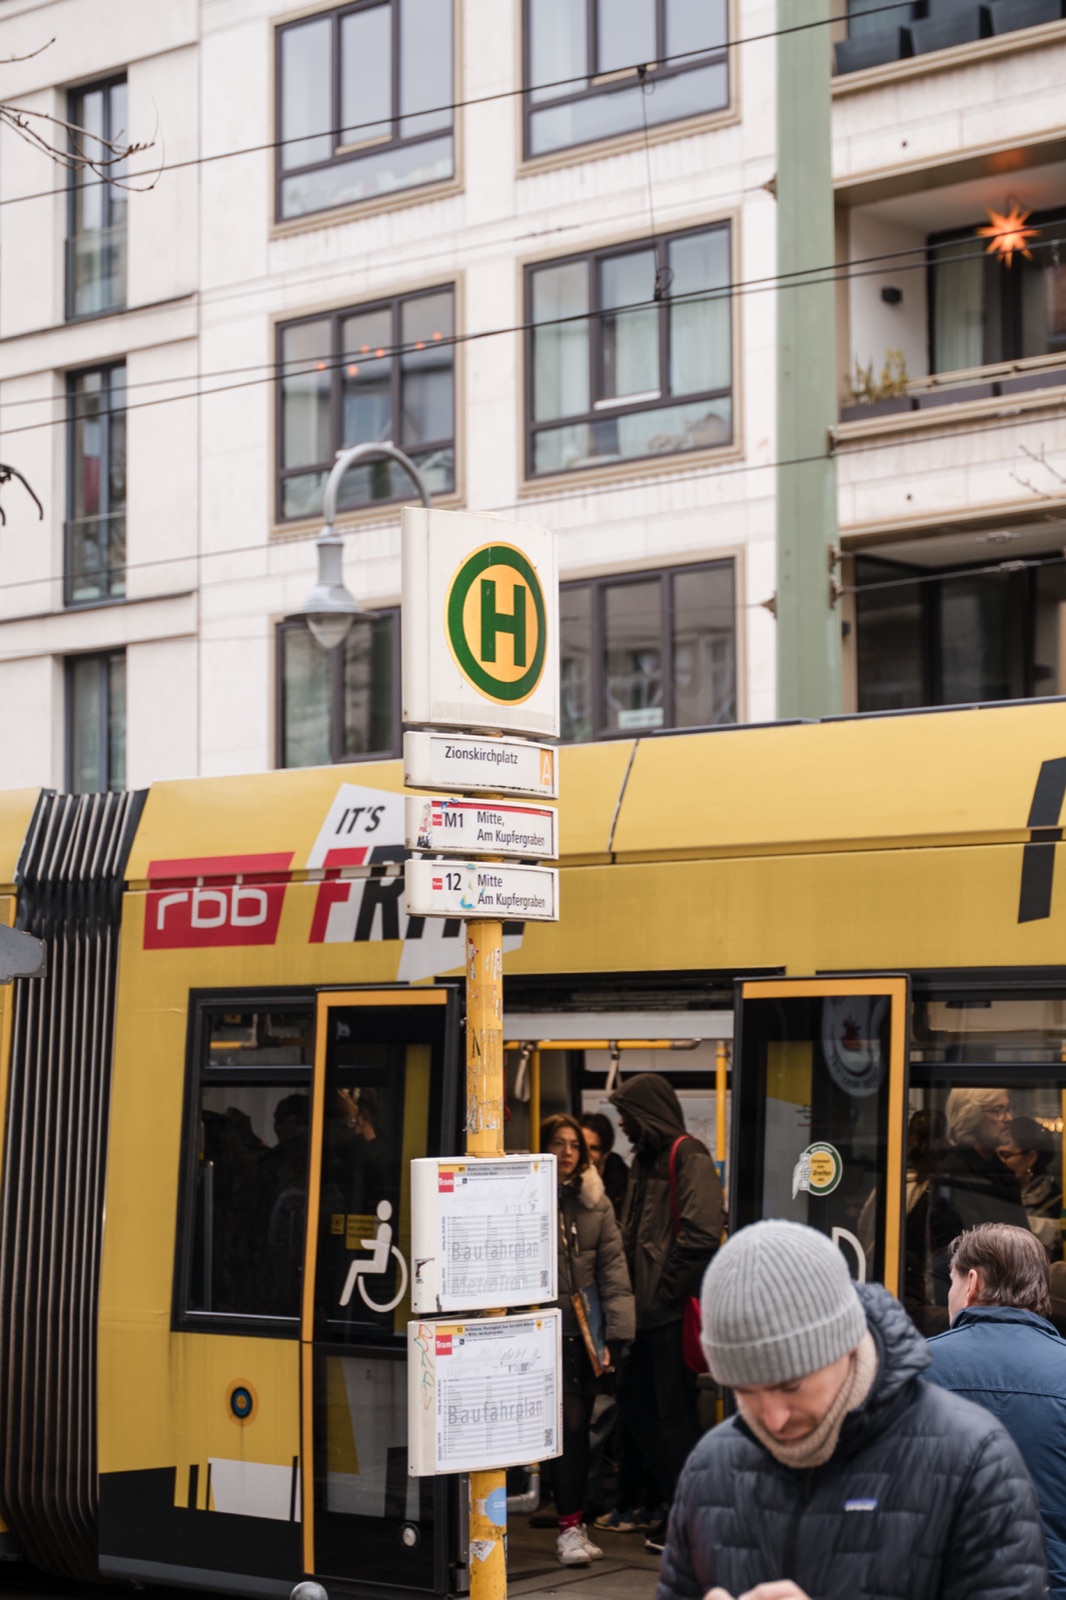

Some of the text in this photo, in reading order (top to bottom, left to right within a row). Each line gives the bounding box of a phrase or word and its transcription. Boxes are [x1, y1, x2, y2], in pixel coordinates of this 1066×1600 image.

[481, 579, 526, 668] H
[445, 746, 518, 765] Zionskirchplatz
[541, 755, 551, 785] A
[335, 805, 386, 834] IT'S
[445, 812, 463, 828] M1
[477, 811, 505, 826] Mitte,
[477, 828, 545, 848] Am Kupfergraben
[445, 873, 462, 891] 12
[477, 874, 503, 887] Mitte
[157, 873, 268, 930] rbb
[477, 893, 545, 910] Am Kupfergraben
[452, 1240, 538, 1261] Baufahrplan
[436, 1341, 452, 1349] Tram
[448, 1397, 543, 1424] Baufahrplan
